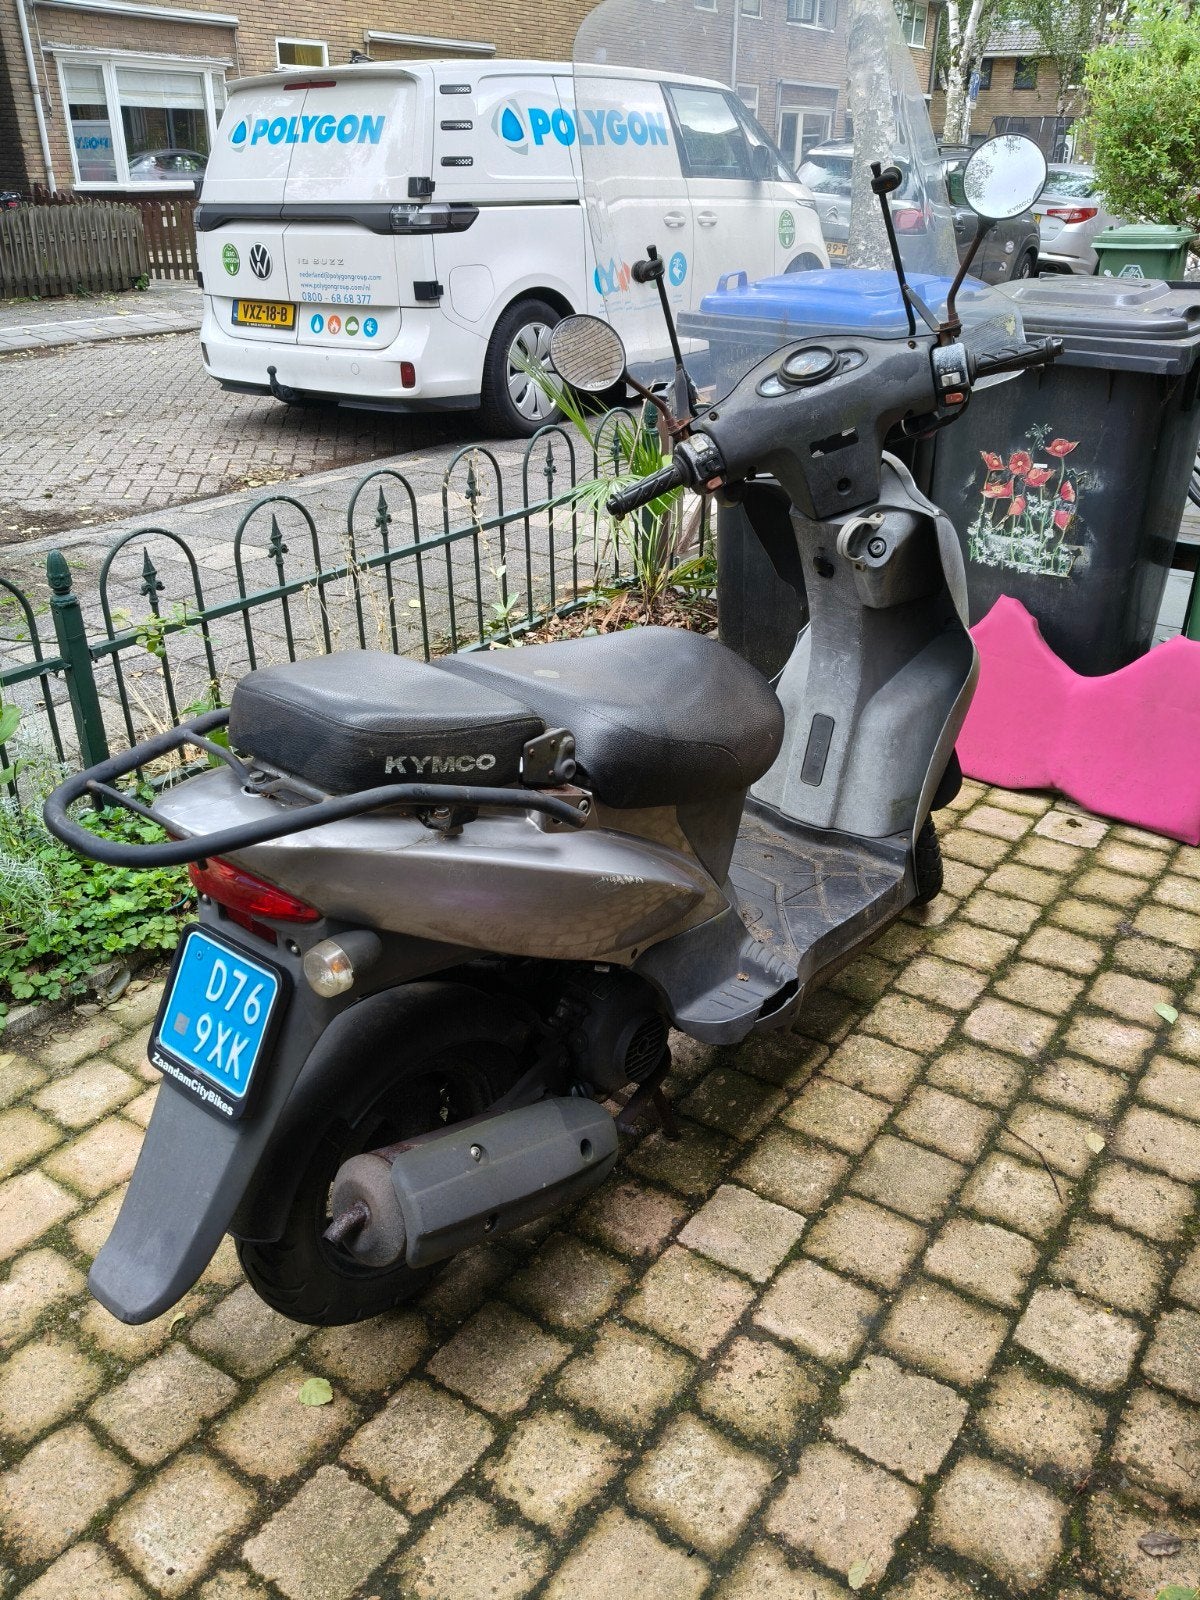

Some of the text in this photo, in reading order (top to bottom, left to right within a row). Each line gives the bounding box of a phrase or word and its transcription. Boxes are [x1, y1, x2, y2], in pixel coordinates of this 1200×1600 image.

[250, 114, 386, 146] POLYGON
[528, 106, 669, 146] POLYGON
[299, 270, 382, 281] nederland@polygongroup.com
[313, 258, 345, 266] BUZZ
[301, 291, 323, 302] 0800
[331, 293, 342, 303] 68
[343, 294, 354, 304] 68
[357, 294, 372, 305] 377
[242, 303, 288, 323] VXZ-18-B
[384, 753, 497, 775] KYMCO
[205, 957, 265, 1025] D76
[193, 1012, 251, 1081] 9XK
[151, 1052, 234, 1116] ZaandamCityBikes
